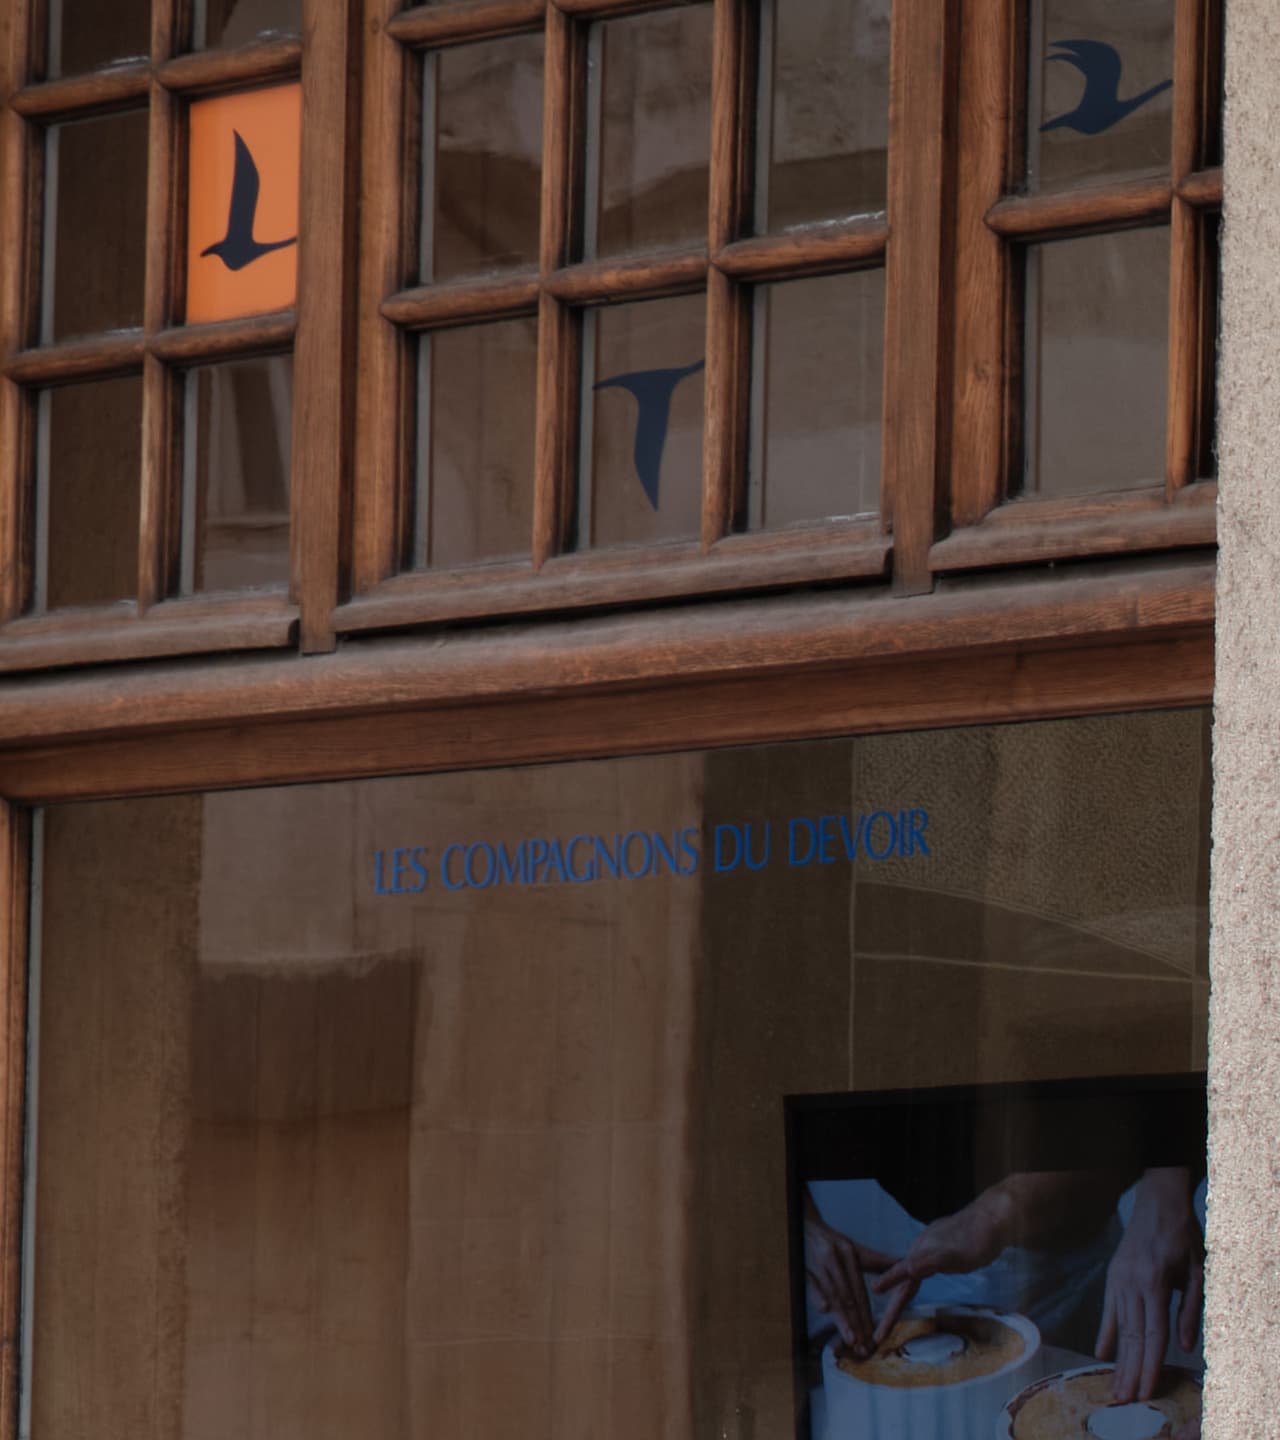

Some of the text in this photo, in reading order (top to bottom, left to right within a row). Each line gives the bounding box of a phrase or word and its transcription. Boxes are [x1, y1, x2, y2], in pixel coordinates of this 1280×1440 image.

[374, 808, 931, 895] LES COMPAGNONS DU DEVOIR
